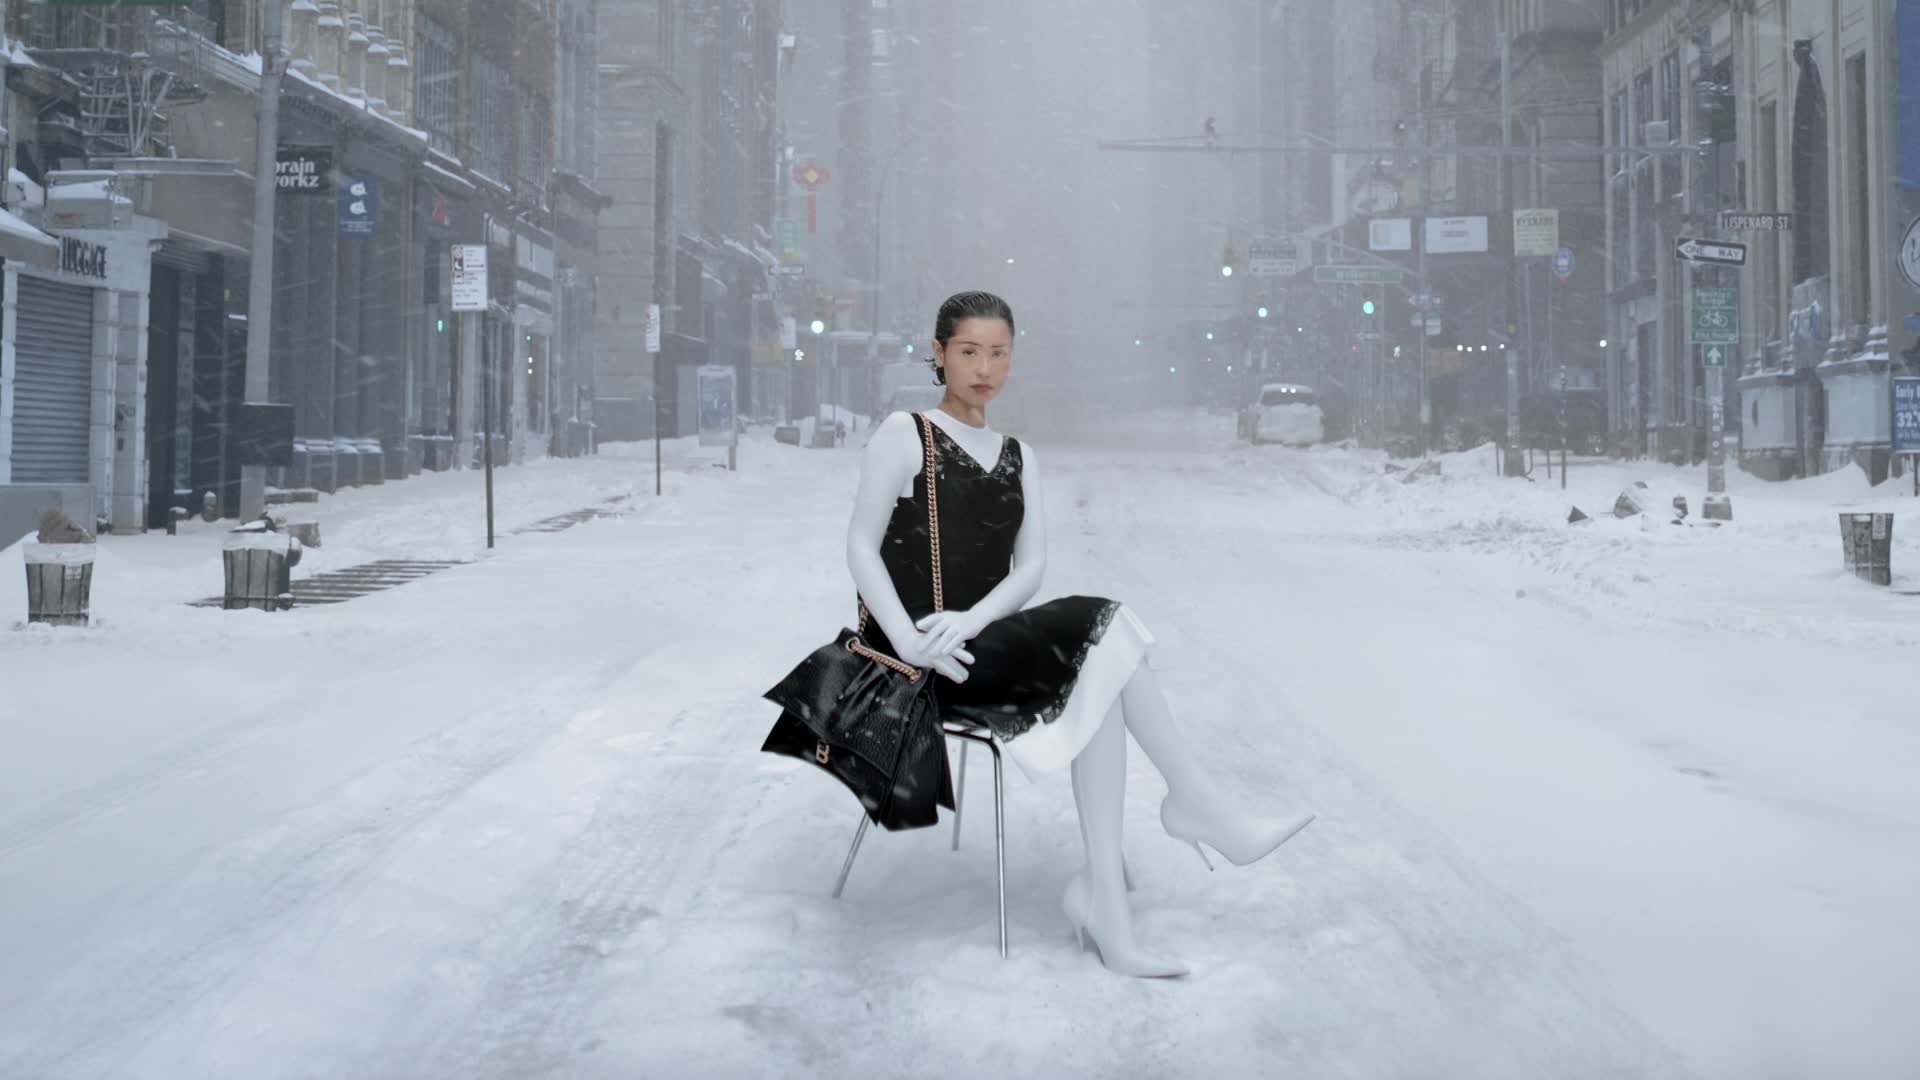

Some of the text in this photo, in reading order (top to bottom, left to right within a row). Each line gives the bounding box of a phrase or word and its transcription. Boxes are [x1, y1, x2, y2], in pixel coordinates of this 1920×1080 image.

[1724, 215, 1789, 230] LISPENARD ST
[1685, 244, 1741, 258] ONE WAY
